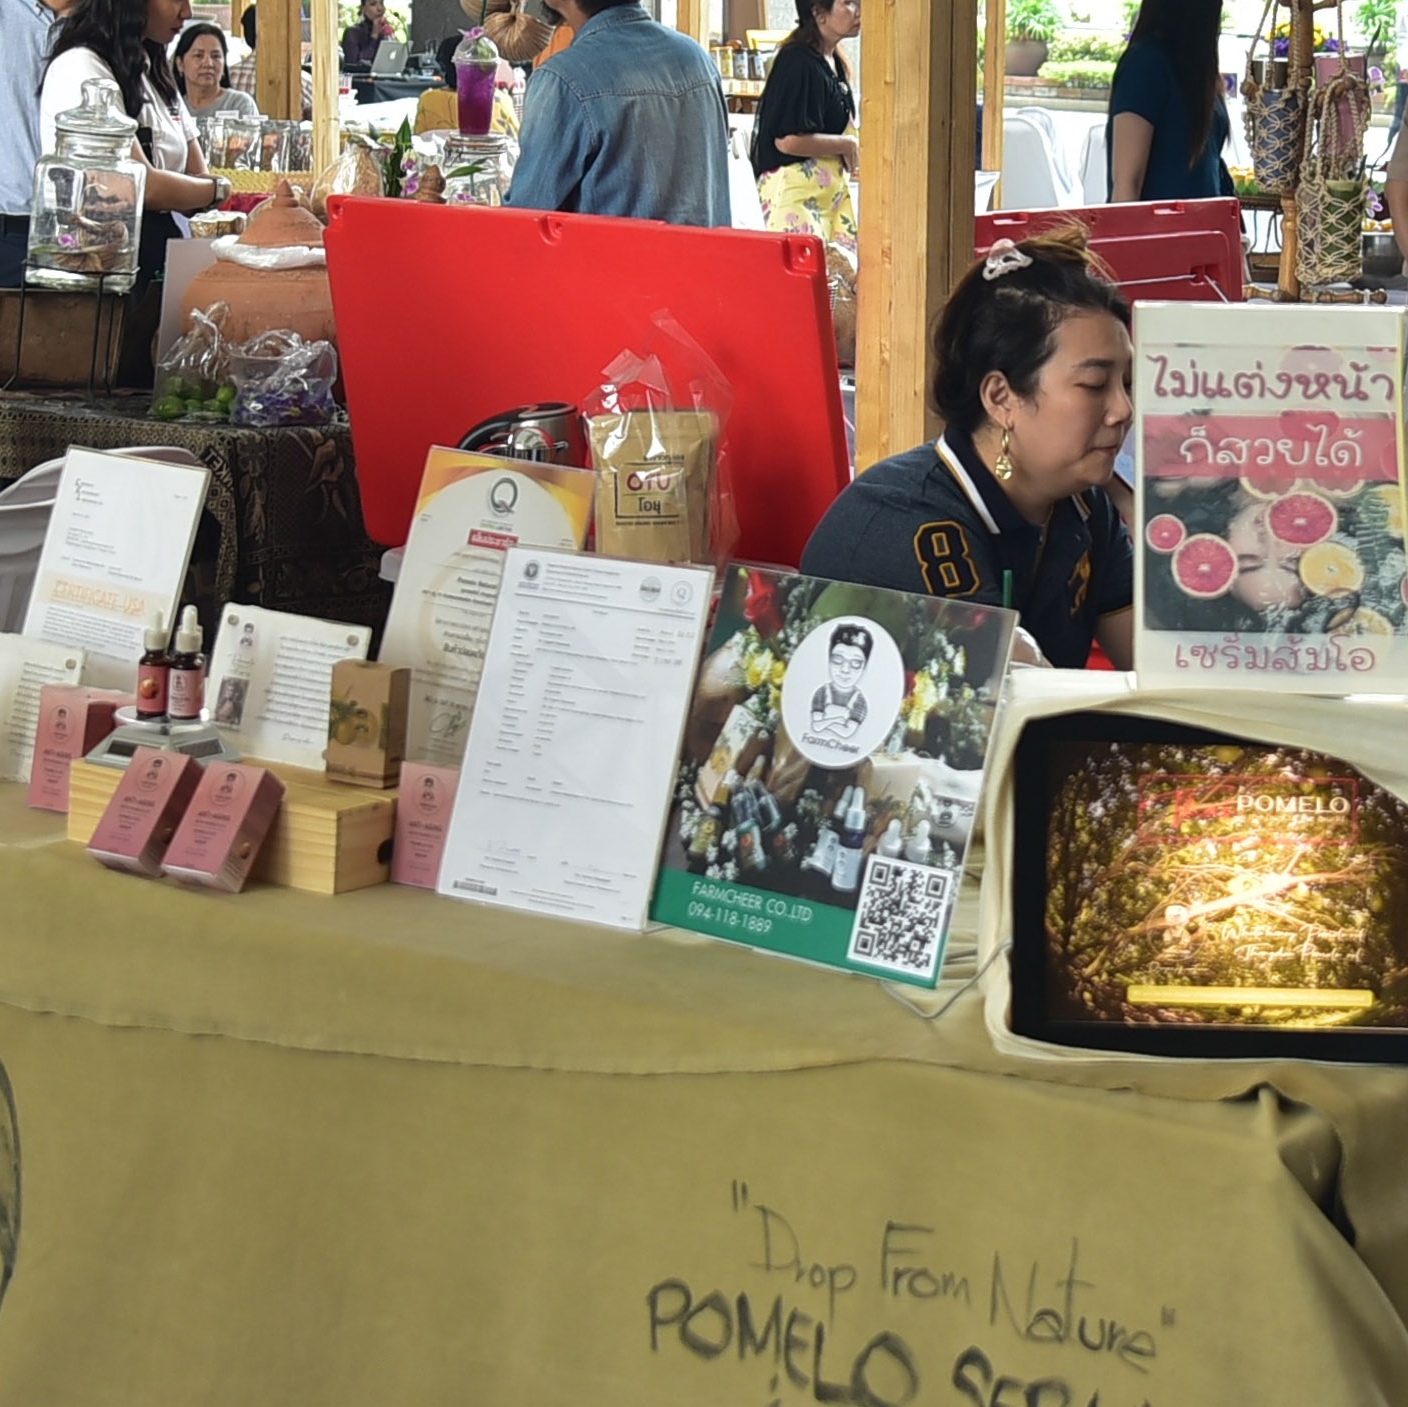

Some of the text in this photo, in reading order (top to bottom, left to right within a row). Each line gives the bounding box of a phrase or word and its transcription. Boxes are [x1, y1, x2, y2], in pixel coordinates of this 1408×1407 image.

[1146, 353, 1394, 401] ไม่แต่งหน้า
[1179, 422, 1365, 467] ก็สวยได้
[913, 520, 981, 598] 8
[1236, 794, 1351, 814] POMELO
[687, 900, 773, 935] 094-118-1889
[692, 880, 763, 912] FARMCHEER
[731, 1178, 1178, 1375] "Drop From Nature"
[647, 1277, 920, 1404] POMELO
